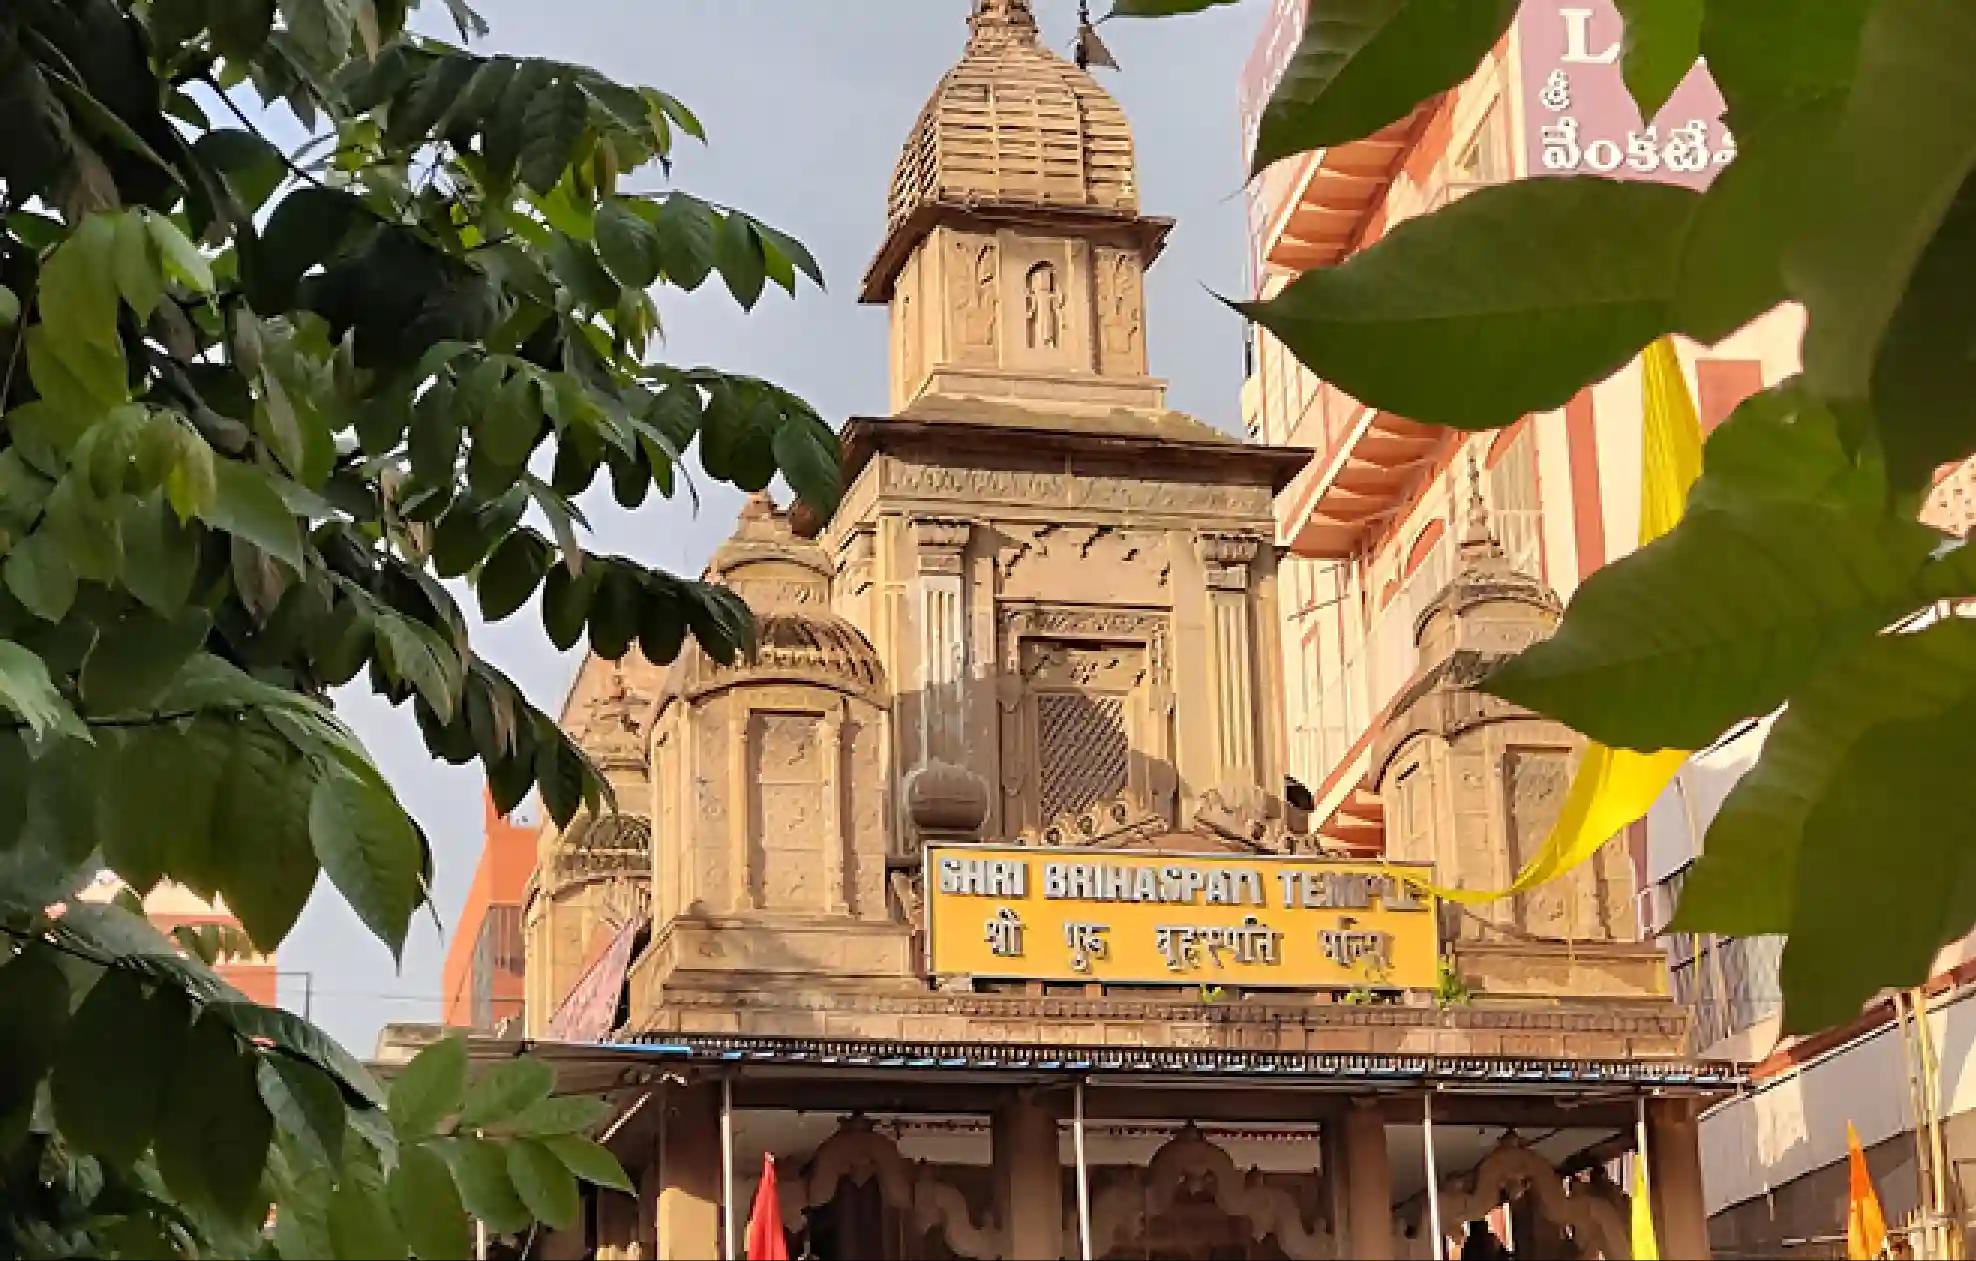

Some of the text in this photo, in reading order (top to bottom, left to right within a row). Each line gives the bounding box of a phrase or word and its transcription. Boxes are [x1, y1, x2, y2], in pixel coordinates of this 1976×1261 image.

[1558, 8, 1621, 64] L
[1539, 69, 1570, 111] శ్రీ
[940, 859, 1430, 911] SHRI BRIHASPATI TEMPLE
[984, 908, 1025, 957] श्री
